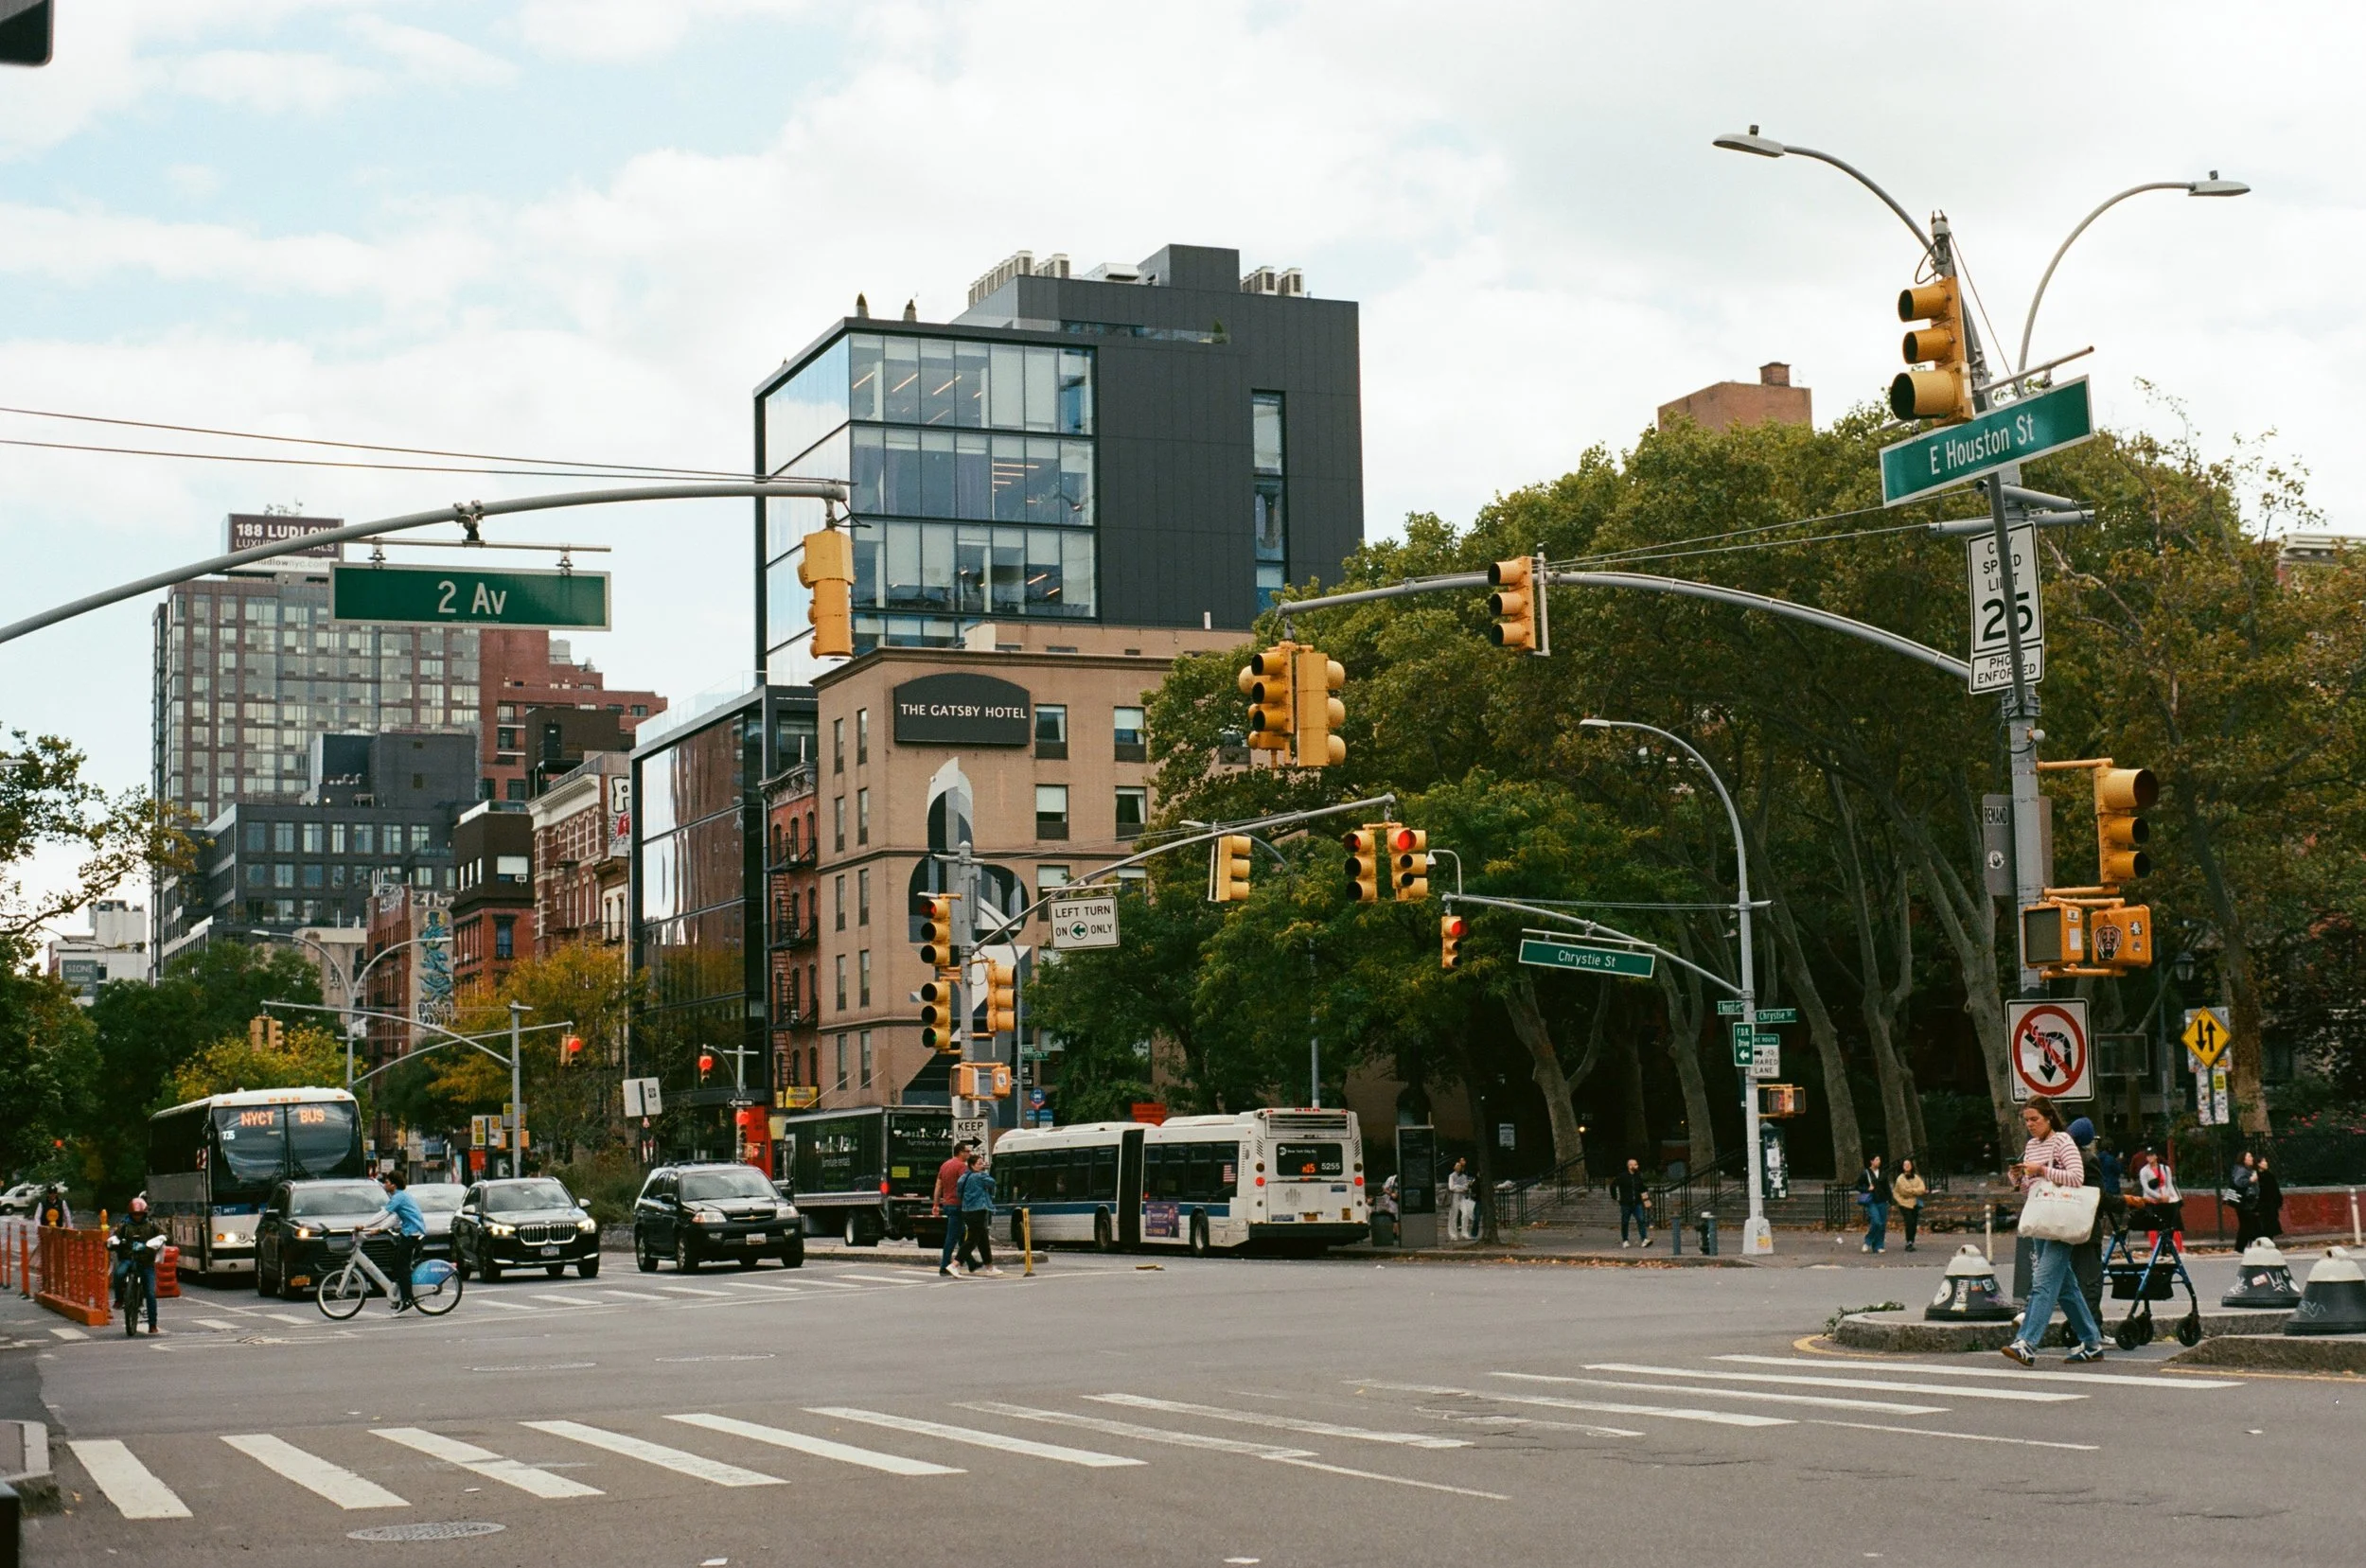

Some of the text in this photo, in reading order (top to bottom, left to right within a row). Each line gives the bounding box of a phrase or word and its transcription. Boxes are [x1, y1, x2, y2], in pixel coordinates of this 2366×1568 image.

[1930, 413, 2034, 475] E Houston St
[237, 523, 263, 537] 188
[438, 580, 506, 614] 2 Av
[1982, 591, 2033, 642] 25
[1977, 663, 2037, 684] ENFORED
[901, 704, 1027, 718] THE GATSBY HOTEL
[1055, 905, 1111, 918] LEFT TURN
[1055, 924, 1113, 937] ON ONLY
[1558, 949, 1616, 967] Chrystie St
[1758, 1011, 1785, 1022] Chrystie
[241, 1108, 326, 1126] NYCT BUS
[958, 1121, 984, 1131] KEEP
[1321, 1162, 1341, 1171] 5255
